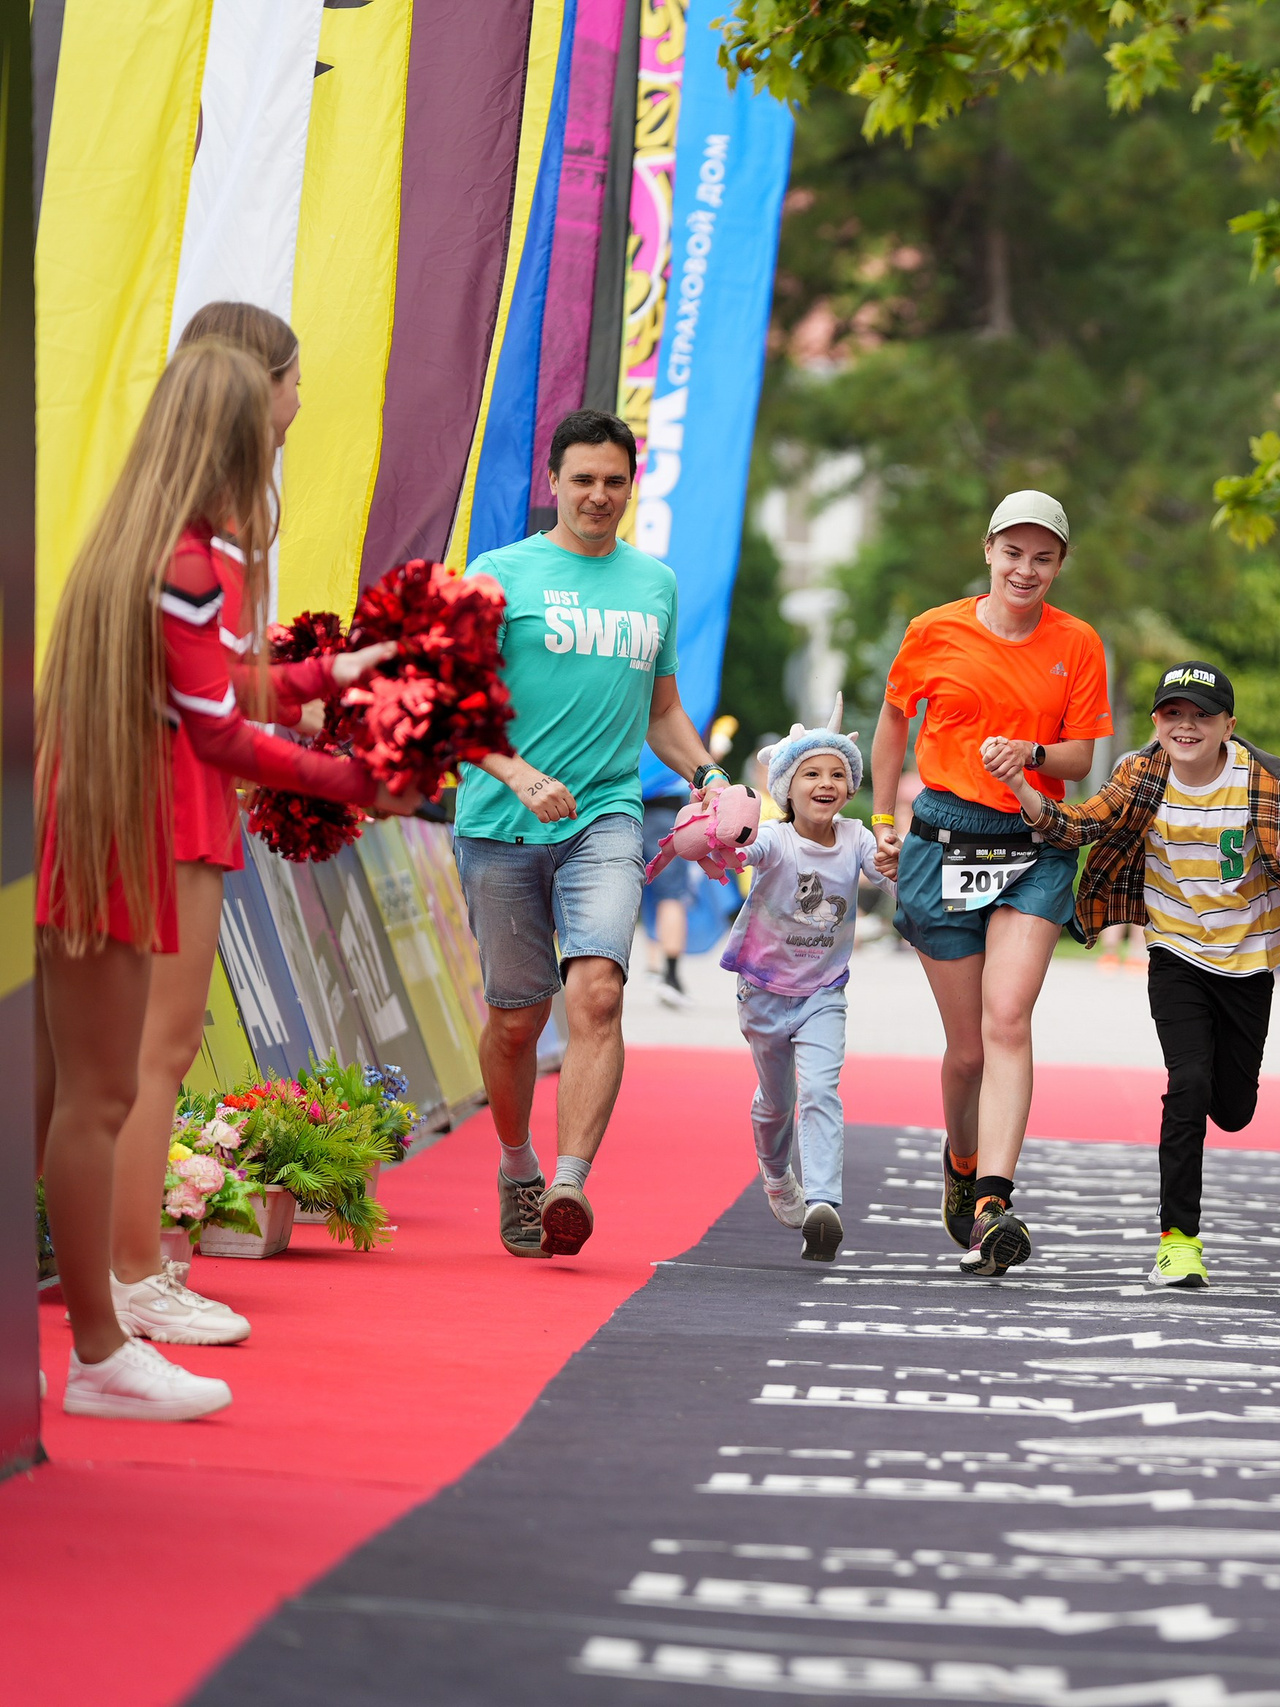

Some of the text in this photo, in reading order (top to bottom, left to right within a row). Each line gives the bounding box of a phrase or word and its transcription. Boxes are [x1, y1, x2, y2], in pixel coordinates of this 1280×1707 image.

[667, 210, 718, 386] СТРАХОВОЙ
[696, 134, 731, 207] ДОМ
[543, 589, 579, 606] JUST
[544, 605, 661, 663] SWIM
[1164, 669, 1216, 684] IRON STAR
[1219, 829, 1245, 881] S
[795, 1319, 1072, 1338] IRON
[760, 1384, 1074, 1412] IRON
[706, 1472, 1073, 1503] IRON
